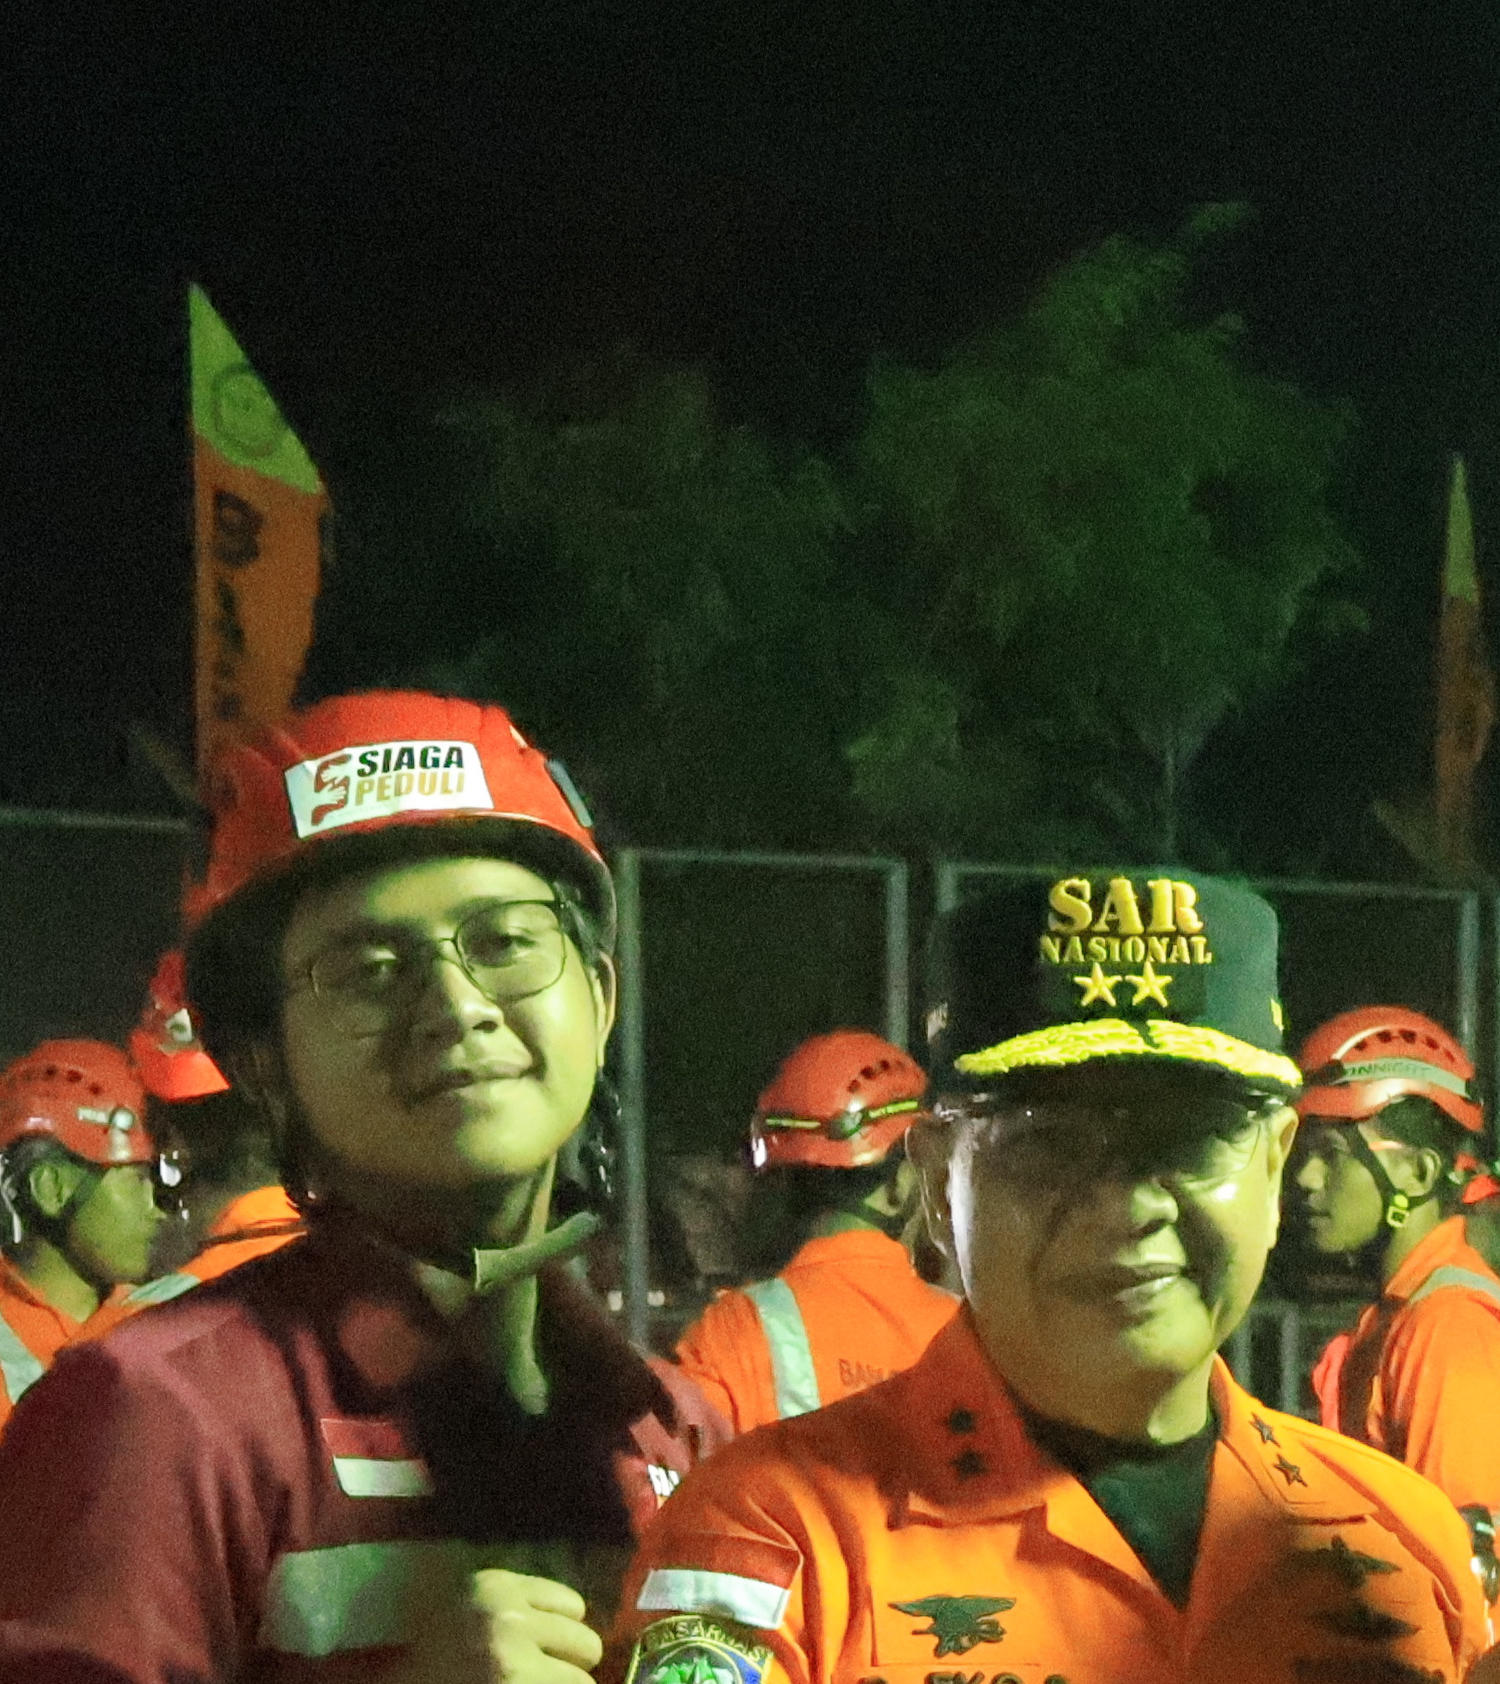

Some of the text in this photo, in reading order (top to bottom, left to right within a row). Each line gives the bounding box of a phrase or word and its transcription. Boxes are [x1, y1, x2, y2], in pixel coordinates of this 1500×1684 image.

[357, 745, 465, 778] SIAGA
[355, 771, 466, 807] PEDULI
[1048, 876, 1204, 935] SAR
[1040, 934, 1213, 965] NASIONAL
